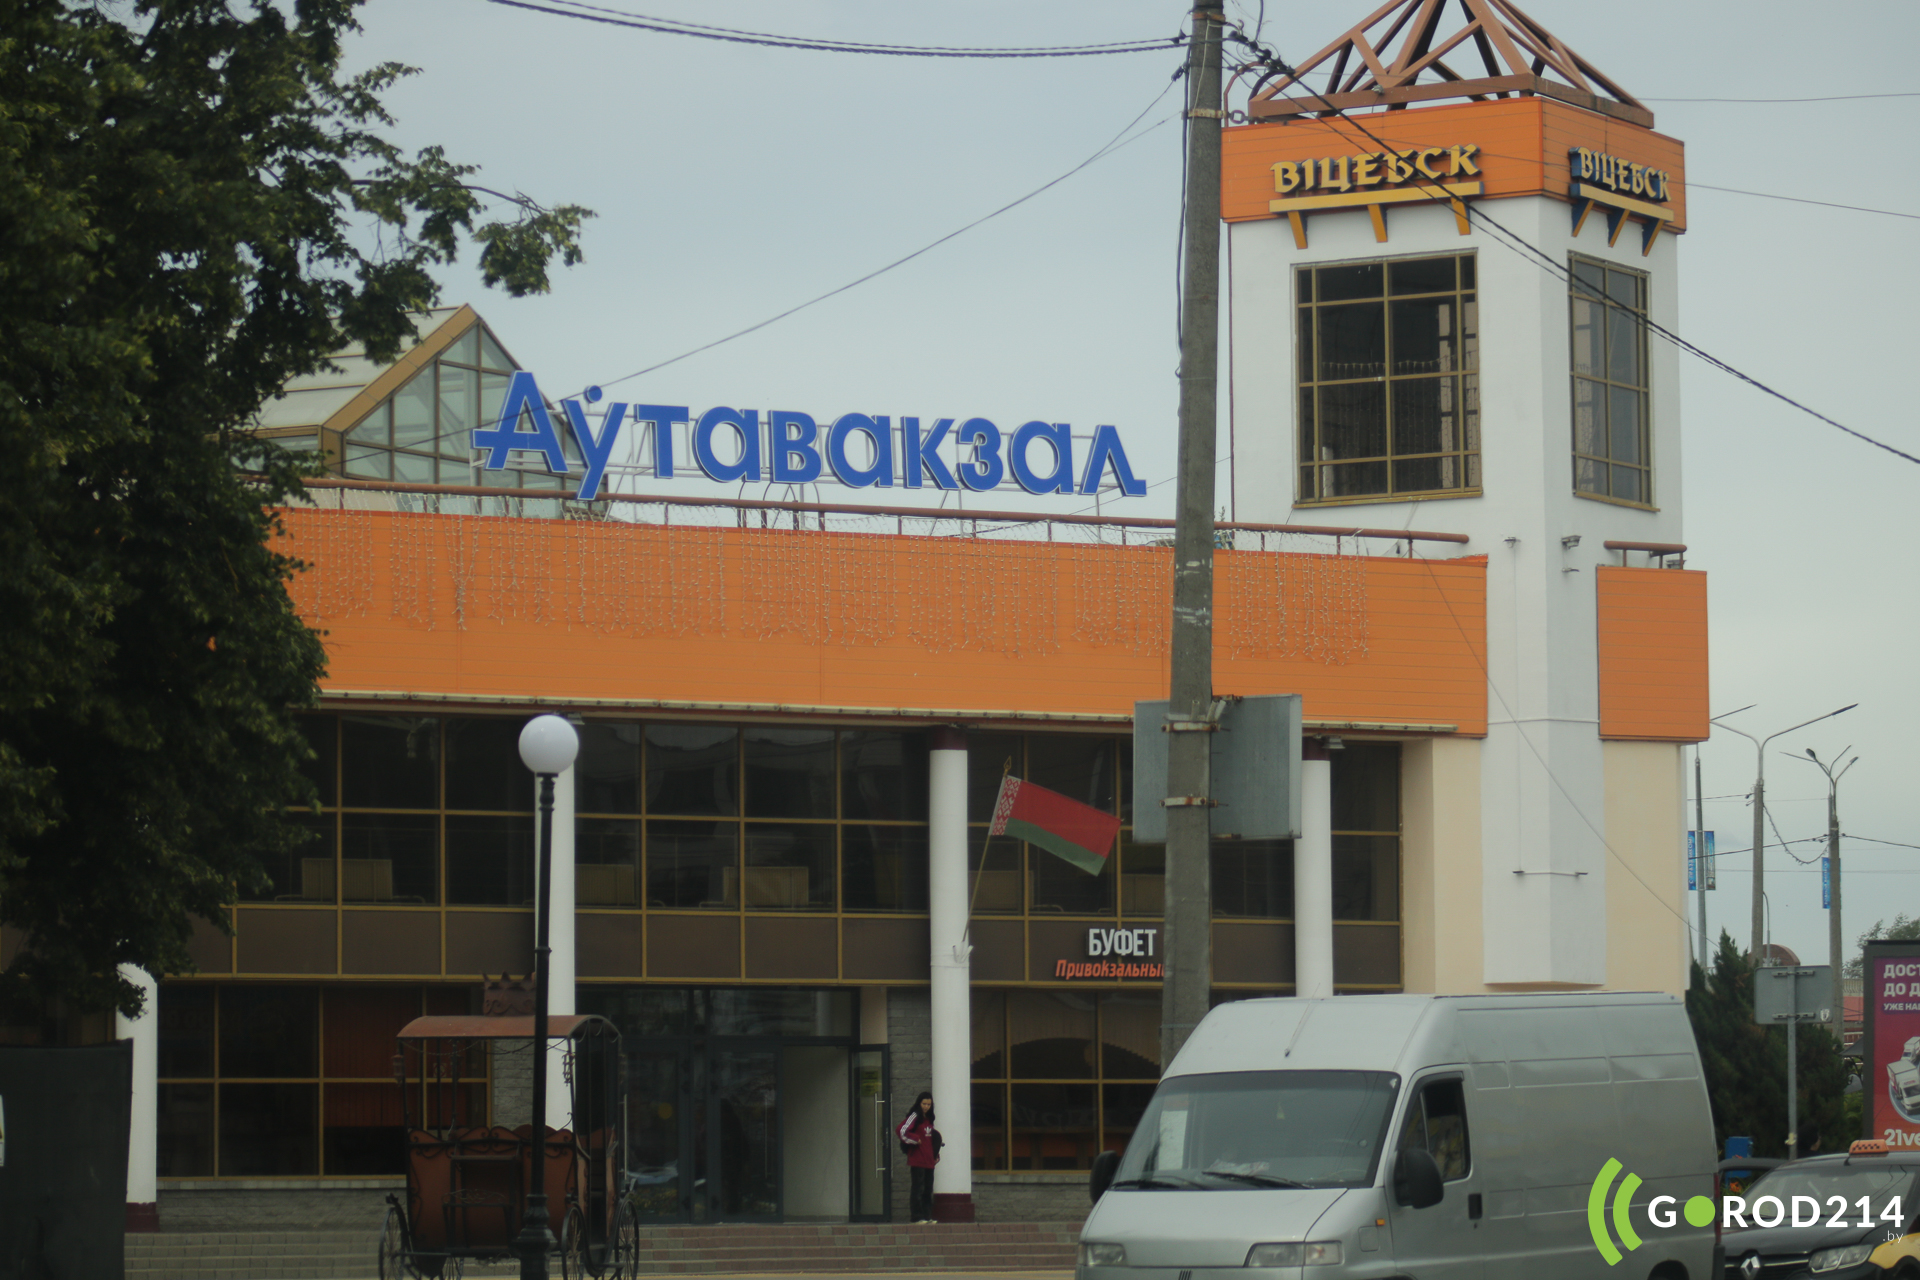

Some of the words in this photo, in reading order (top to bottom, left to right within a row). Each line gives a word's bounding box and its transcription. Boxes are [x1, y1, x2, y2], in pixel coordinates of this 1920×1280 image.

[1270, 143, 1483, 193] ВІЦЕБСК
[1574, 146, 1672, 202] ВІЦЕБСК
[473, 371, 1146, 500] Аўтавакзал
[1088, 928, 1157, 956] БУФЕТ
[1883, 983, 1907, 997] ДО
[1883, 1003, 1904, 1011] УЖЕ
